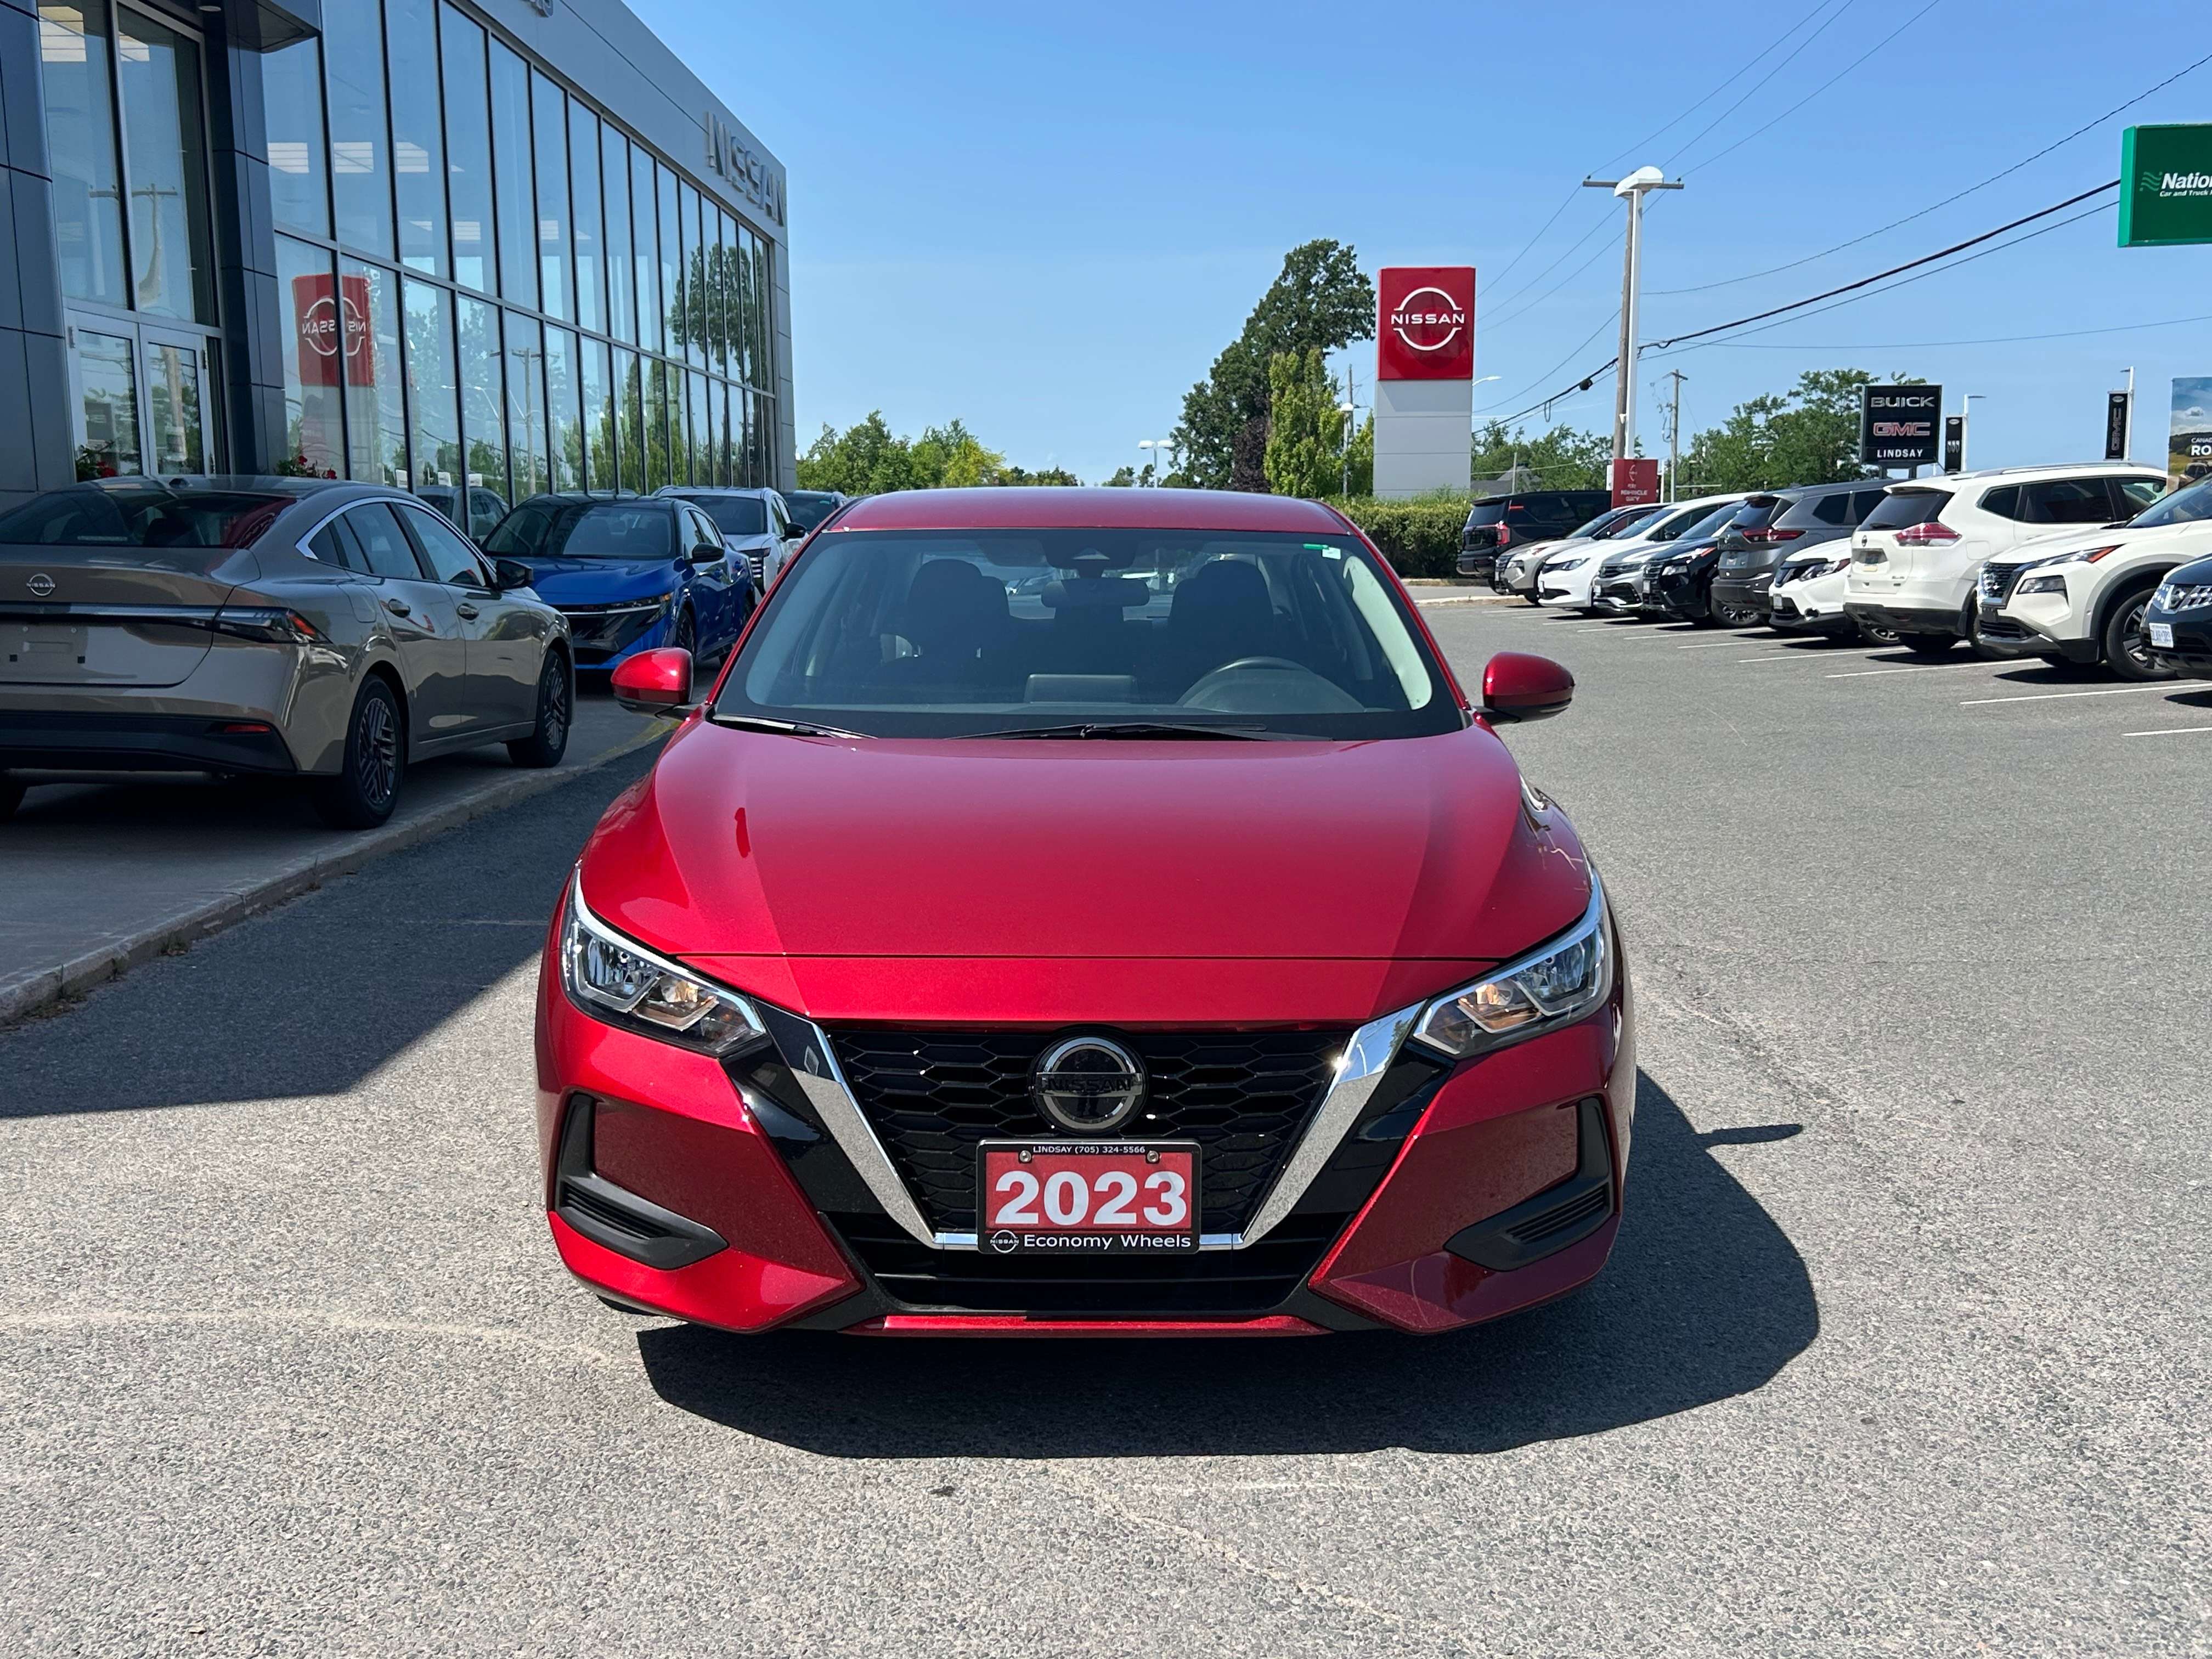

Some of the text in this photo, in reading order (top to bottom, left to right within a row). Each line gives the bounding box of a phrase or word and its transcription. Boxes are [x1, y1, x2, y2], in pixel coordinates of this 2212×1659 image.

[707, 111, 784, 227] NISSAN
[1391, 313, 1465, 324] NISSAN
[1871, 397, 1935, 408] BUICK
[1873, 422, 1931, 436] GMC
[1877, 449, 1923, 458] LINDSAY
[2191, 445, 2212, 455] RO
[1047, 1078, 1132, 1092] NISSAN
[1075, 1146, 1099, 1154] (705)
[995, 1170, 1187, 1226] 2023
[1024, 1234, 1192, 1250] Economy Wheels
